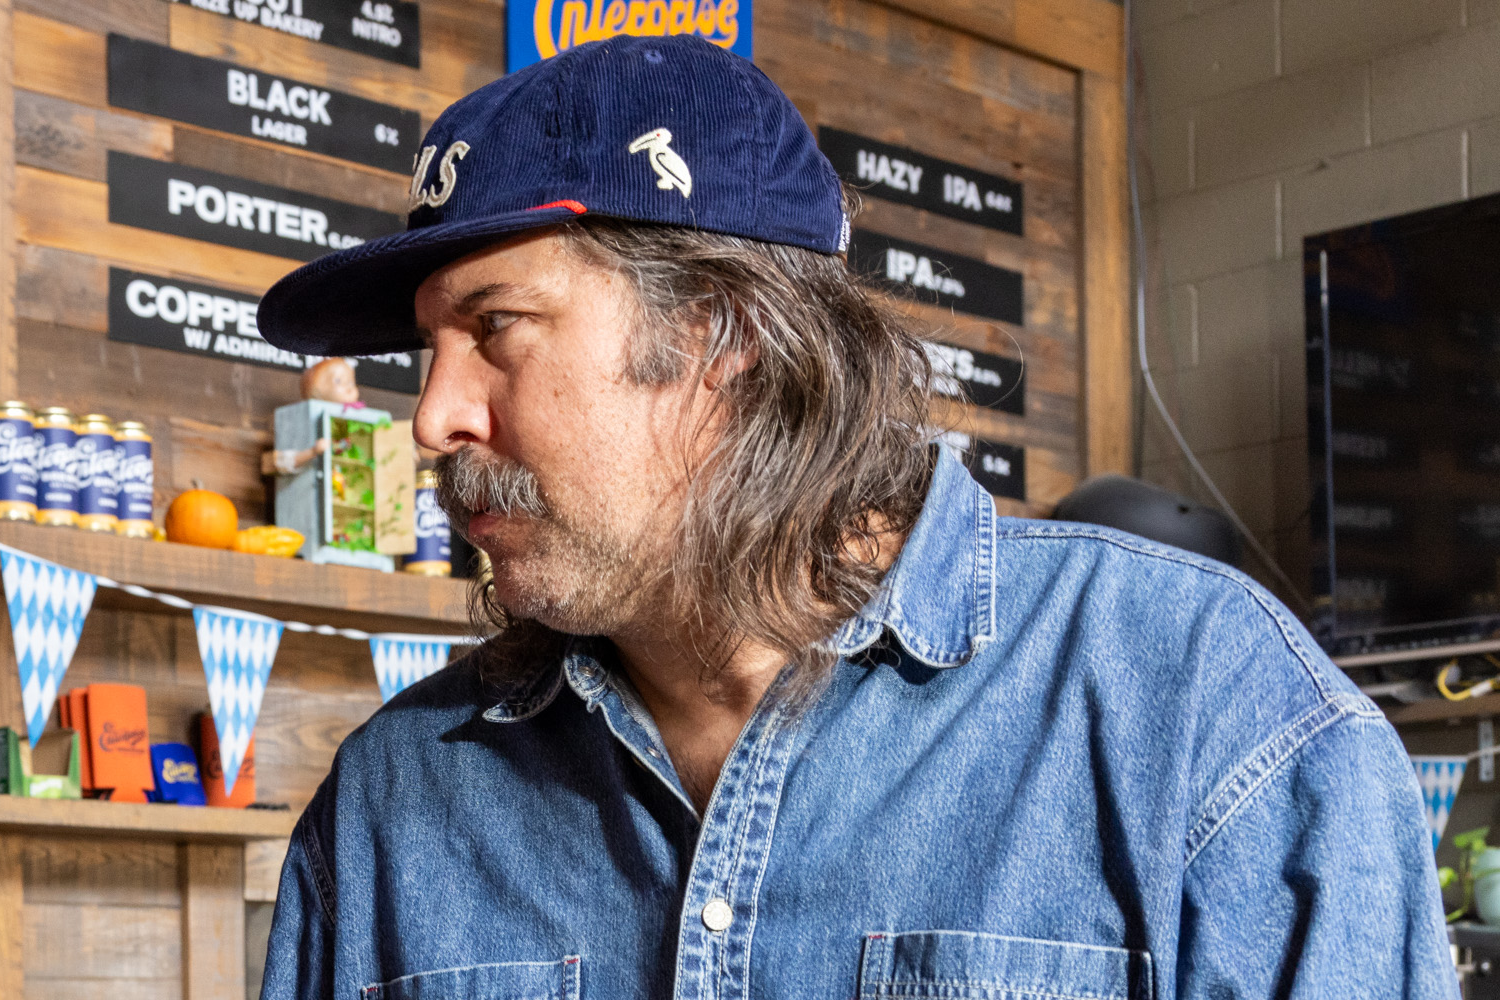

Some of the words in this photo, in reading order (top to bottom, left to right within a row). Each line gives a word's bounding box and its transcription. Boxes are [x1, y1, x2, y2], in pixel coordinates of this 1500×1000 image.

[260, 6, 324, 41] BAKERY
[352, 16, 402, 47] NITRO
[227, 68, 332, 127] BLACK
[251, 115, 307, 146] LAGER
[857, 150, 924, 194] HAZY
[943, 174, 982, 211] IPA
[167, 179, 328, 247] PORTER
[886, 247, 934, 290] IPA
[125, 279, 262, 340] COPPE
[183, 326, 211, 351] W/
[214, 335, 304, 369] ADMIRAL
